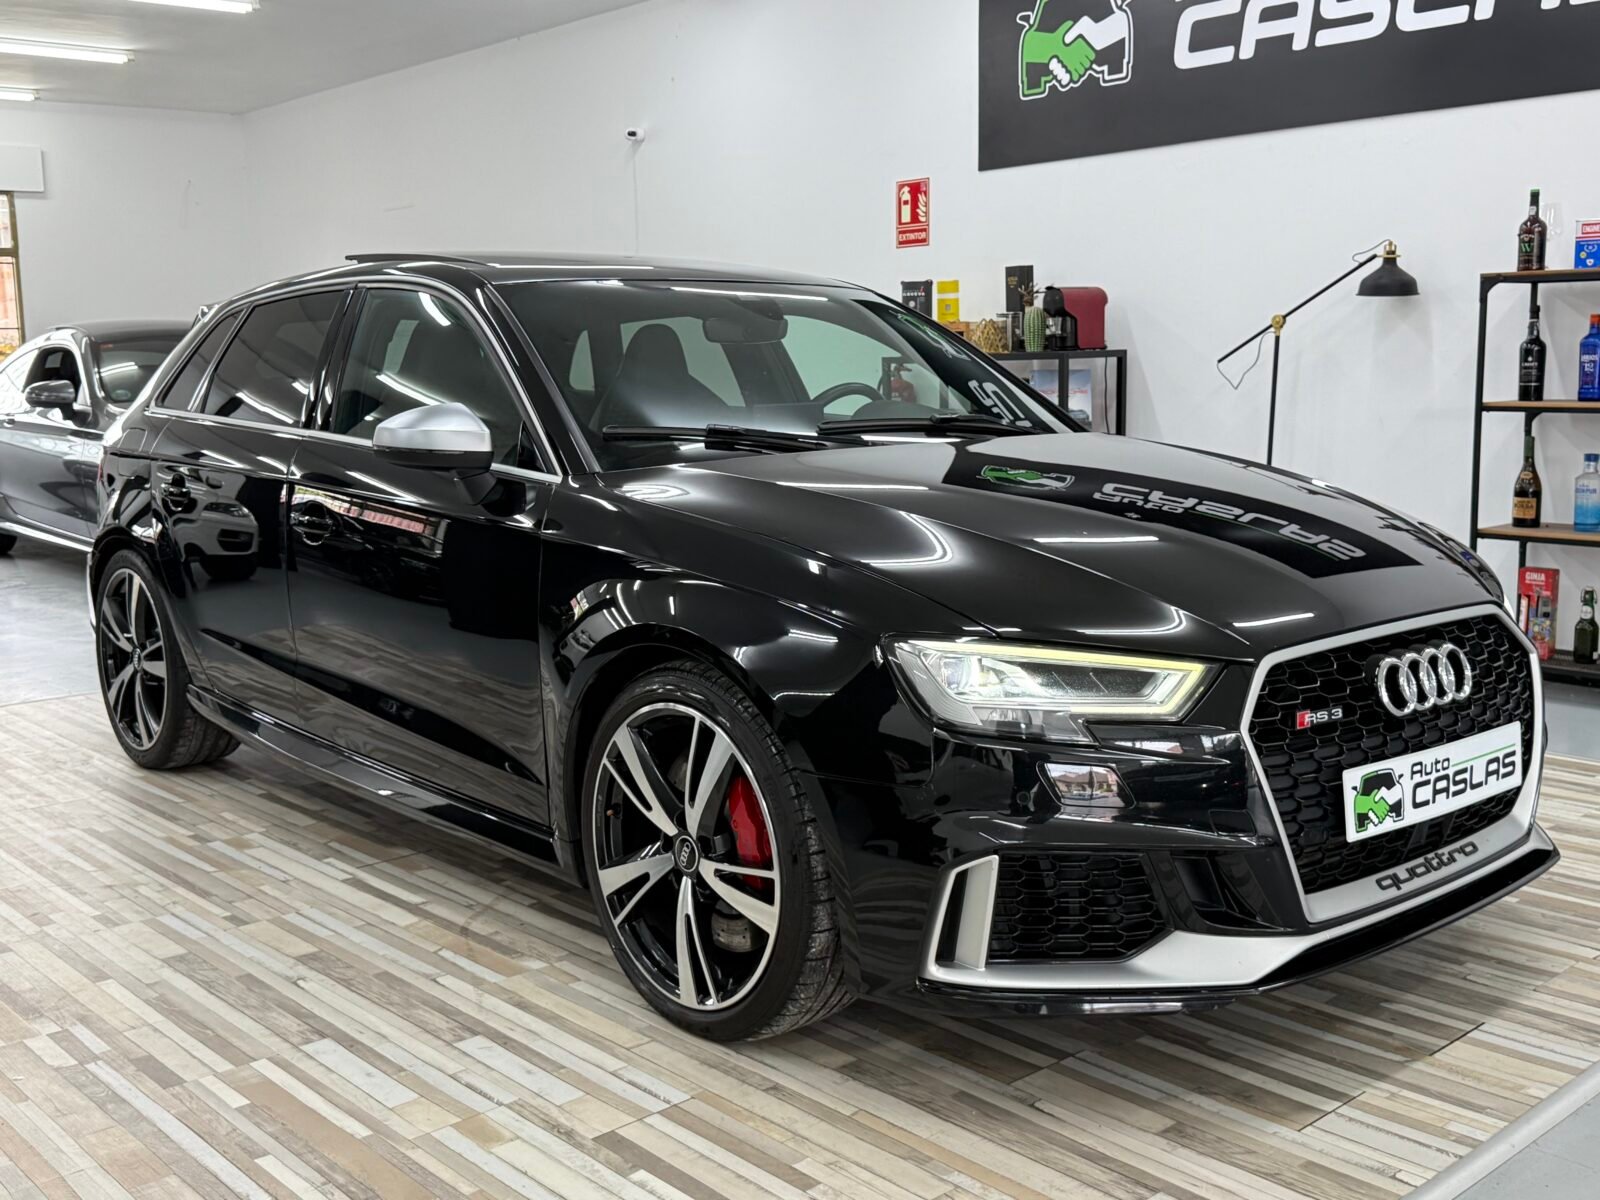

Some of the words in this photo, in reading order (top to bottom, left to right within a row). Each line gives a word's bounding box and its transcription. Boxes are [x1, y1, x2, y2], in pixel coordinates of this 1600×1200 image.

[899, 231, 926, 242] EXTINTOR
[1410, 757, 1450, 780] Auto
[1411, 750, 1516, 810] CASLAS
[1375, 841, 1478, 891] quattro
